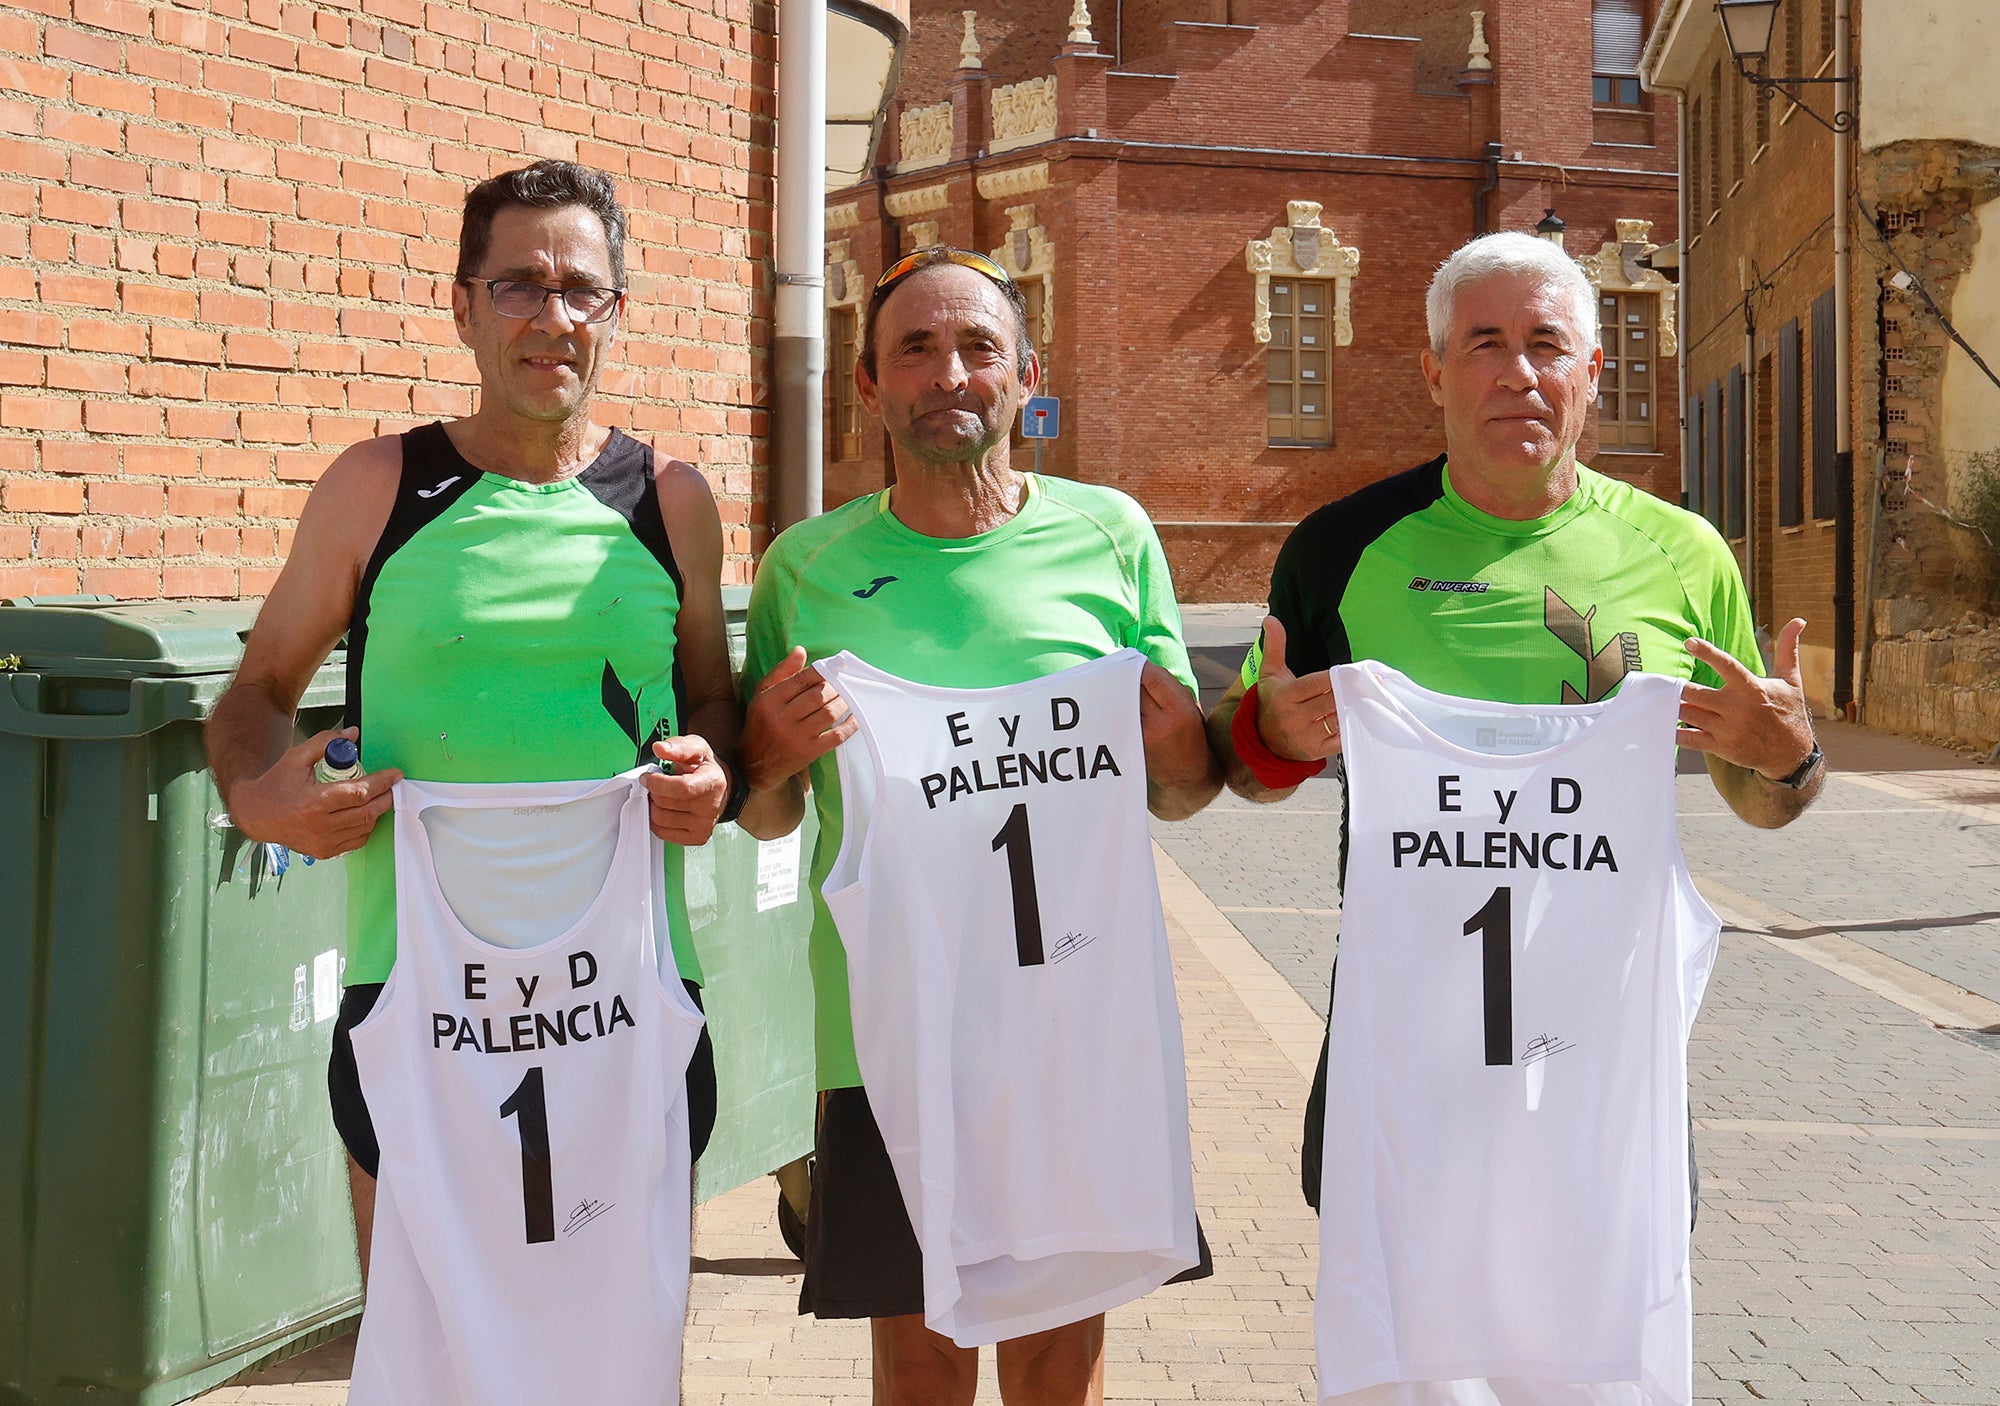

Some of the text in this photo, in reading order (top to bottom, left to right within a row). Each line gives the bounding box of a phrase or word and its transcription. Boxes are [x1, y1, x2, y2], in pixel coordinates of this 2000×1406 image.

[1431, 580, 1488, 592] INVERSE
[946, 697, 1080, 748] E y D
[920, 744, 1122, 810] PALENCIA
[1438, 775, 1582, 825] E y D
[1392, 831, 1619, 873] PALENCIA
[991, 802, 1045, 968] 1
[464, 950, 598, 1009] E y D
[1463, 886, 1513, 1066] 1
[432, 994, 636, 1054] PALENCIA
[499, 1066, 556, 1245] 1
